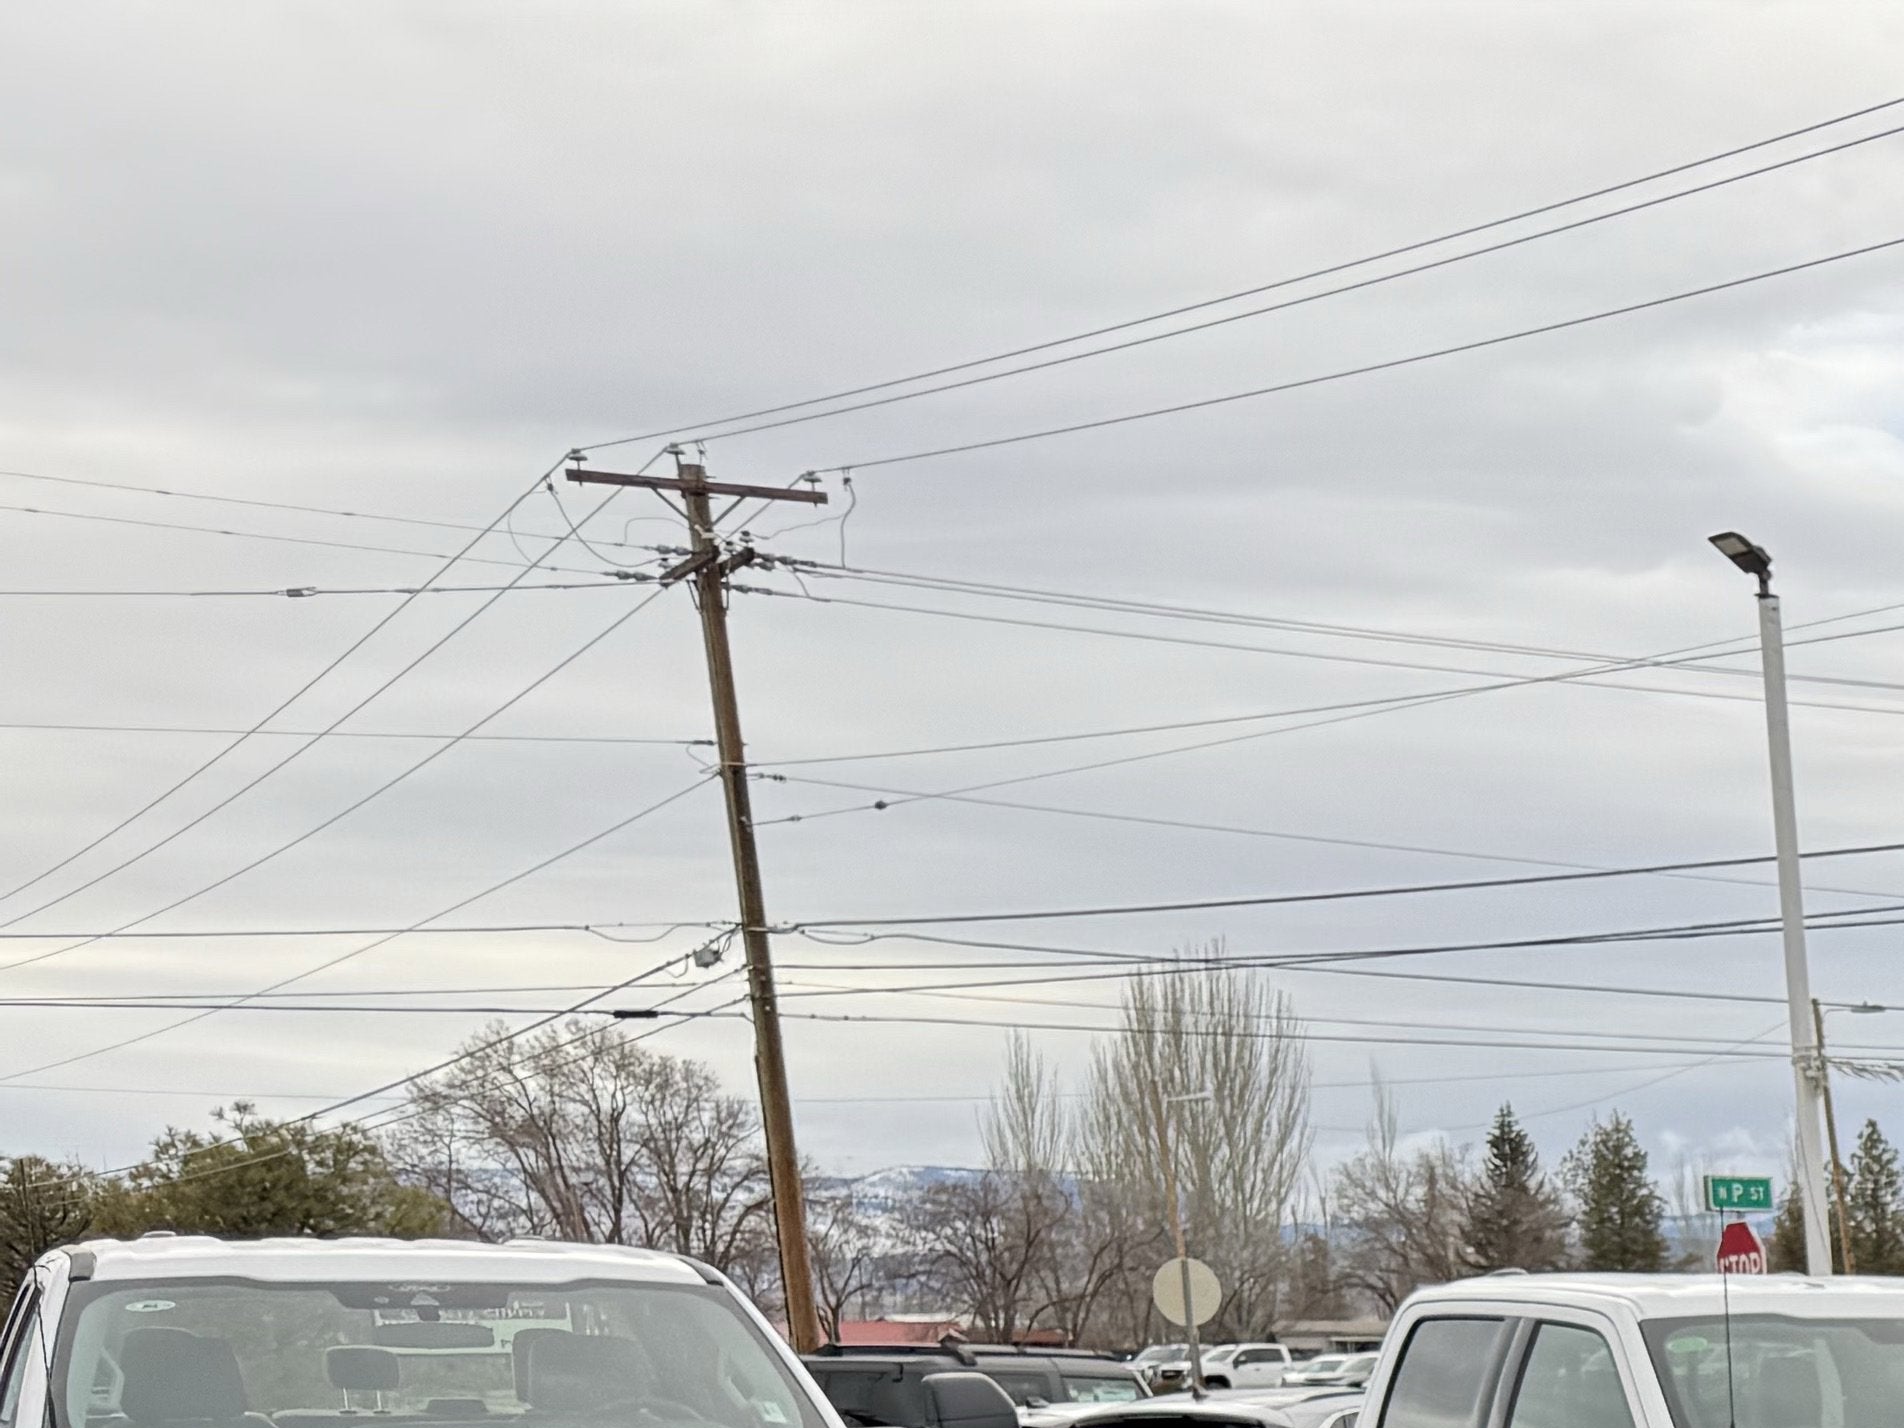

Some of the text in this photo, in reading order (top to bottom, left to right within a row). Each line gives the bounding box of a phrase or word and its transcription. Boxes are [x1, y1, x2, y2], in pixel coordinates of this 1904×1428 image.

[1718, 1182, 1764, 1203] N P ST
